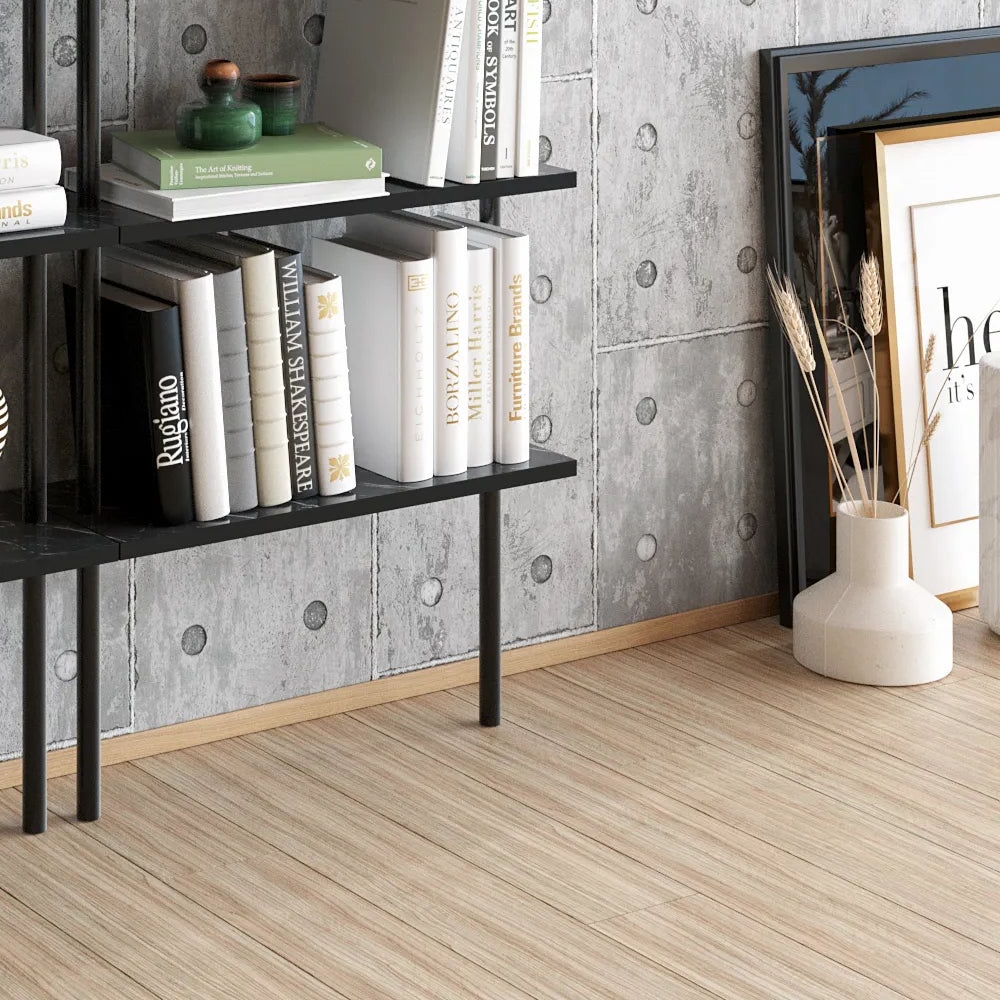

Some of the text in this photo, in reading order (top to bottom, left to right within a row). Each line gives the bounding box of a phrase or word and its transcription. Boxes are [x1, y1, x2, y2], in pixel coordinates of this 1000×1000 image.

[442, 7, 464, 124] ANTIQUAIRES
[483, 56, 498, 146] SYMBOLS
[486, 40, 493, 53] OF
[226, 164, 253, 172] Knitting
[280, 259, 314, 494] WILLIAM SHAKESPEARE
[415, 306, 424, 442] EICHHOLTZ
[446, 291, 460, 425] BORZALINO
[467, 283, 483, 422] Miller Harris
[508, 273, 522, 422] Furniture Brands
[152, 374, 189, 470] Rugiano
